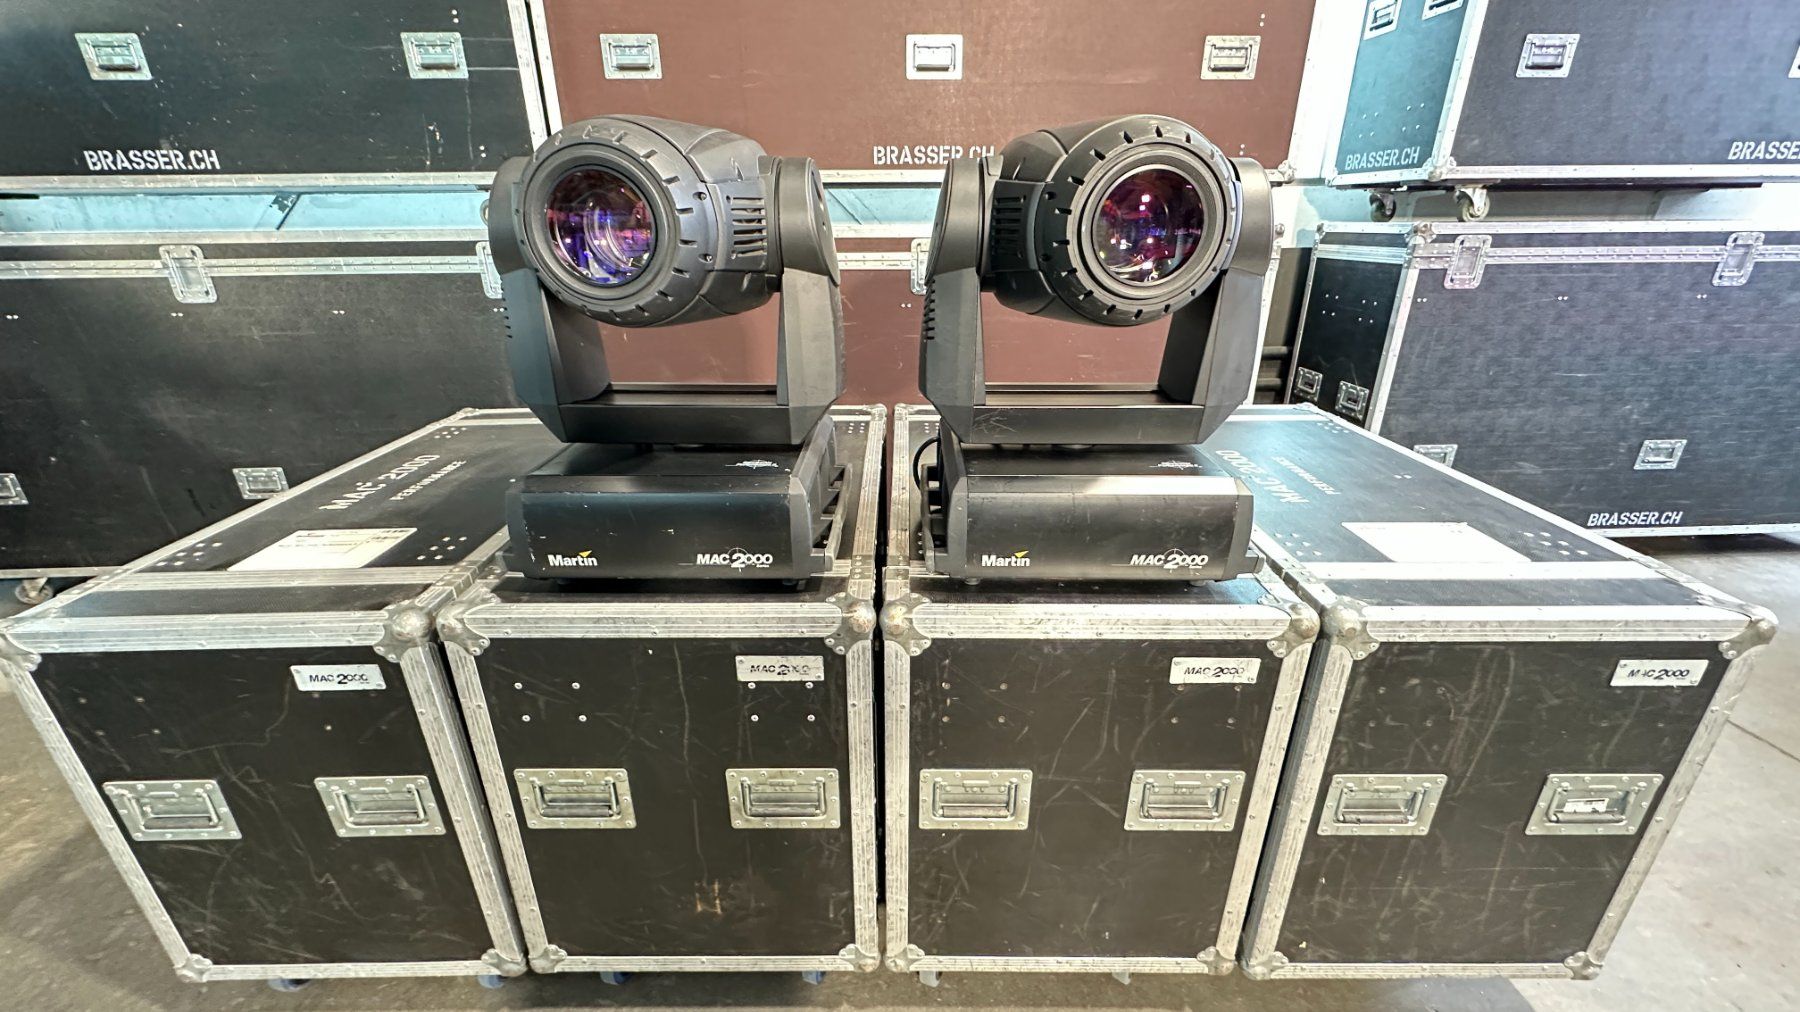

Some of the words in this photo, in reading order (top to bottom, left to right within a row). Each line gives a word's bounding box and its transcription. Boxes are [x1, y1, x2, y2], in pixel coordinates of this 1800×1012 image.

[83, 149, 221, 171] BRASSER.CH
[873, 144, 995, 165] BRASSERCH
[1344, 145, 1421, 171] BRASSER.CH
[1727, 140, 1800, 160] BRASSE
[377, 454, 441, 480] 2000
[1587, 510, 1683, 527] BRASSER.CH
[547, 550, 598, 567] Martin
[981, 551, 1031, 567] Martin
